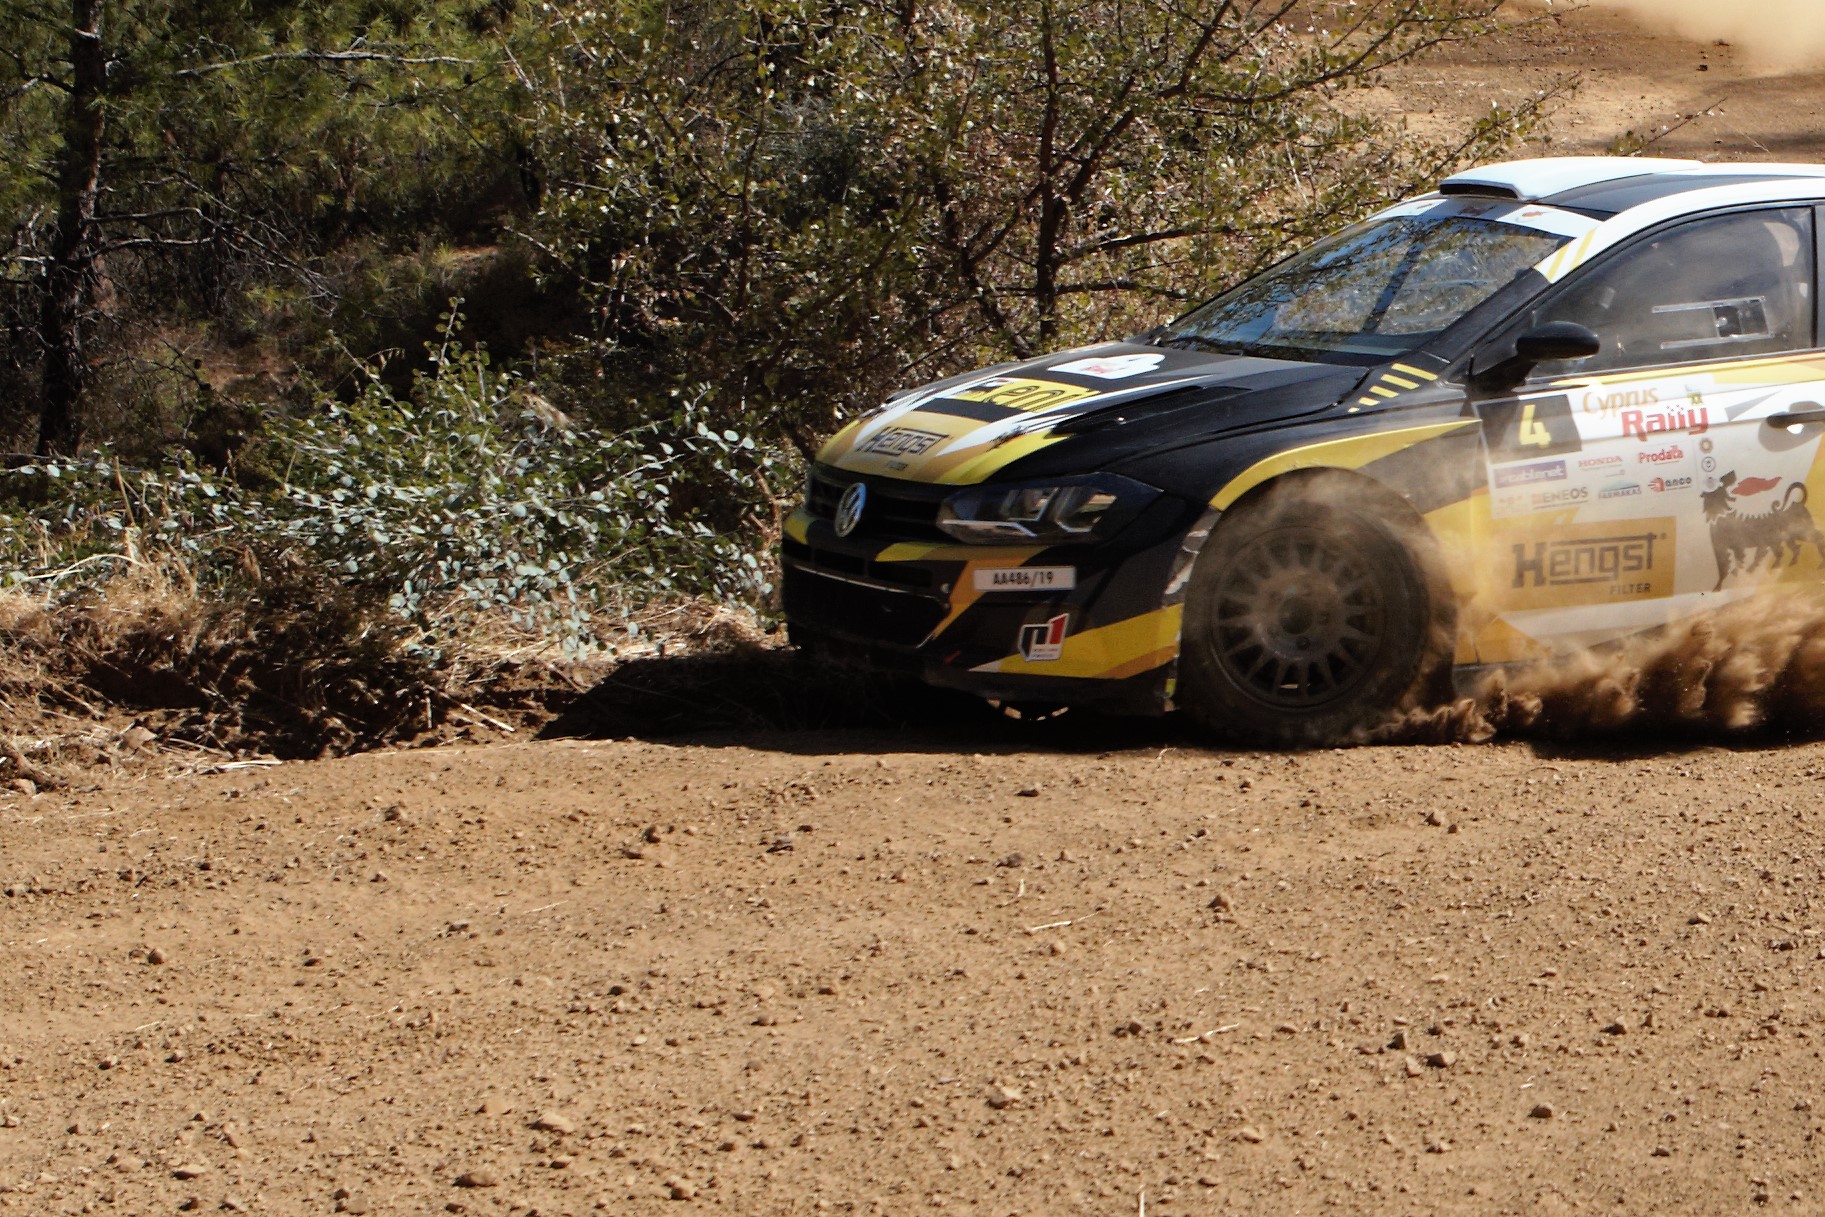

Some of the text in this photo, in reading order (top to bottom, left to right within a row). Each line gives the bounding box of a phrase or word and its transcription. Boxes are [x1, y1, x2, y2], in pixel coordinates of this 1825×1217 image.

[1583, 387, 1660, 420] Cyprus
[1519, 404, 1552, 449] 4
[1621, 404, 1709, 442] Rally
[1578, 455, 1623, 467] HONDA
[1511, 532, 1658, 589] Hengst
[993, 571, 1054, 587] AA486/19
[1609, 582, 1651, 596] FILTER
